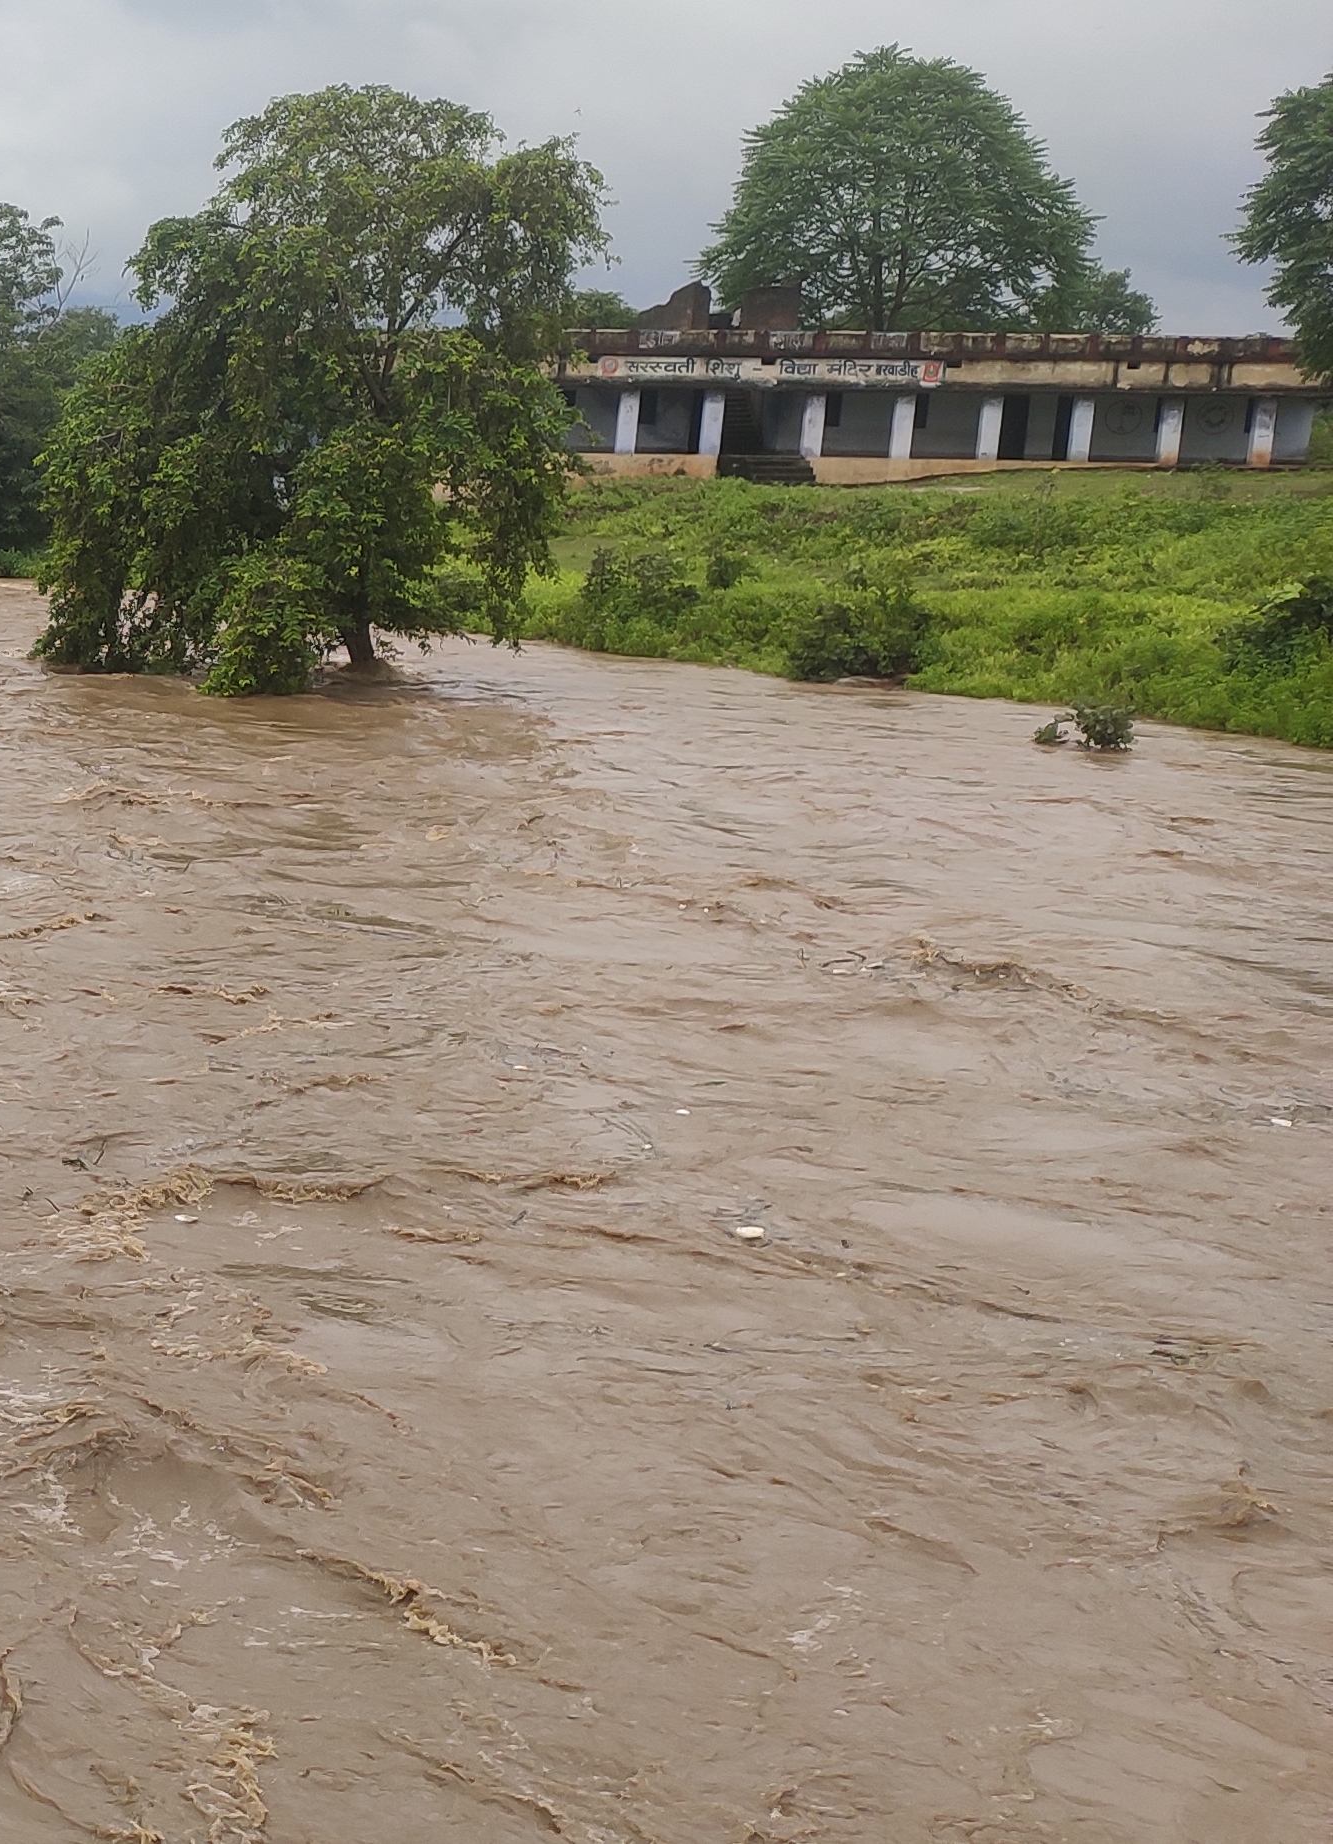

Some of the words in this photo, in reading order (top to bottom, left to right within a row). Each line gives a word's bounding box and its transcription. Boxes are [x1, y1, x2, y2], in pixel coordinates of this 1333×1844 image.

[625, 357, 696, 374] सरस्वती
[705, 357, 743, 380] शिशु
[779, 359, 818, 377] विद्या
[826, 359, 874, 378] मंदिर
